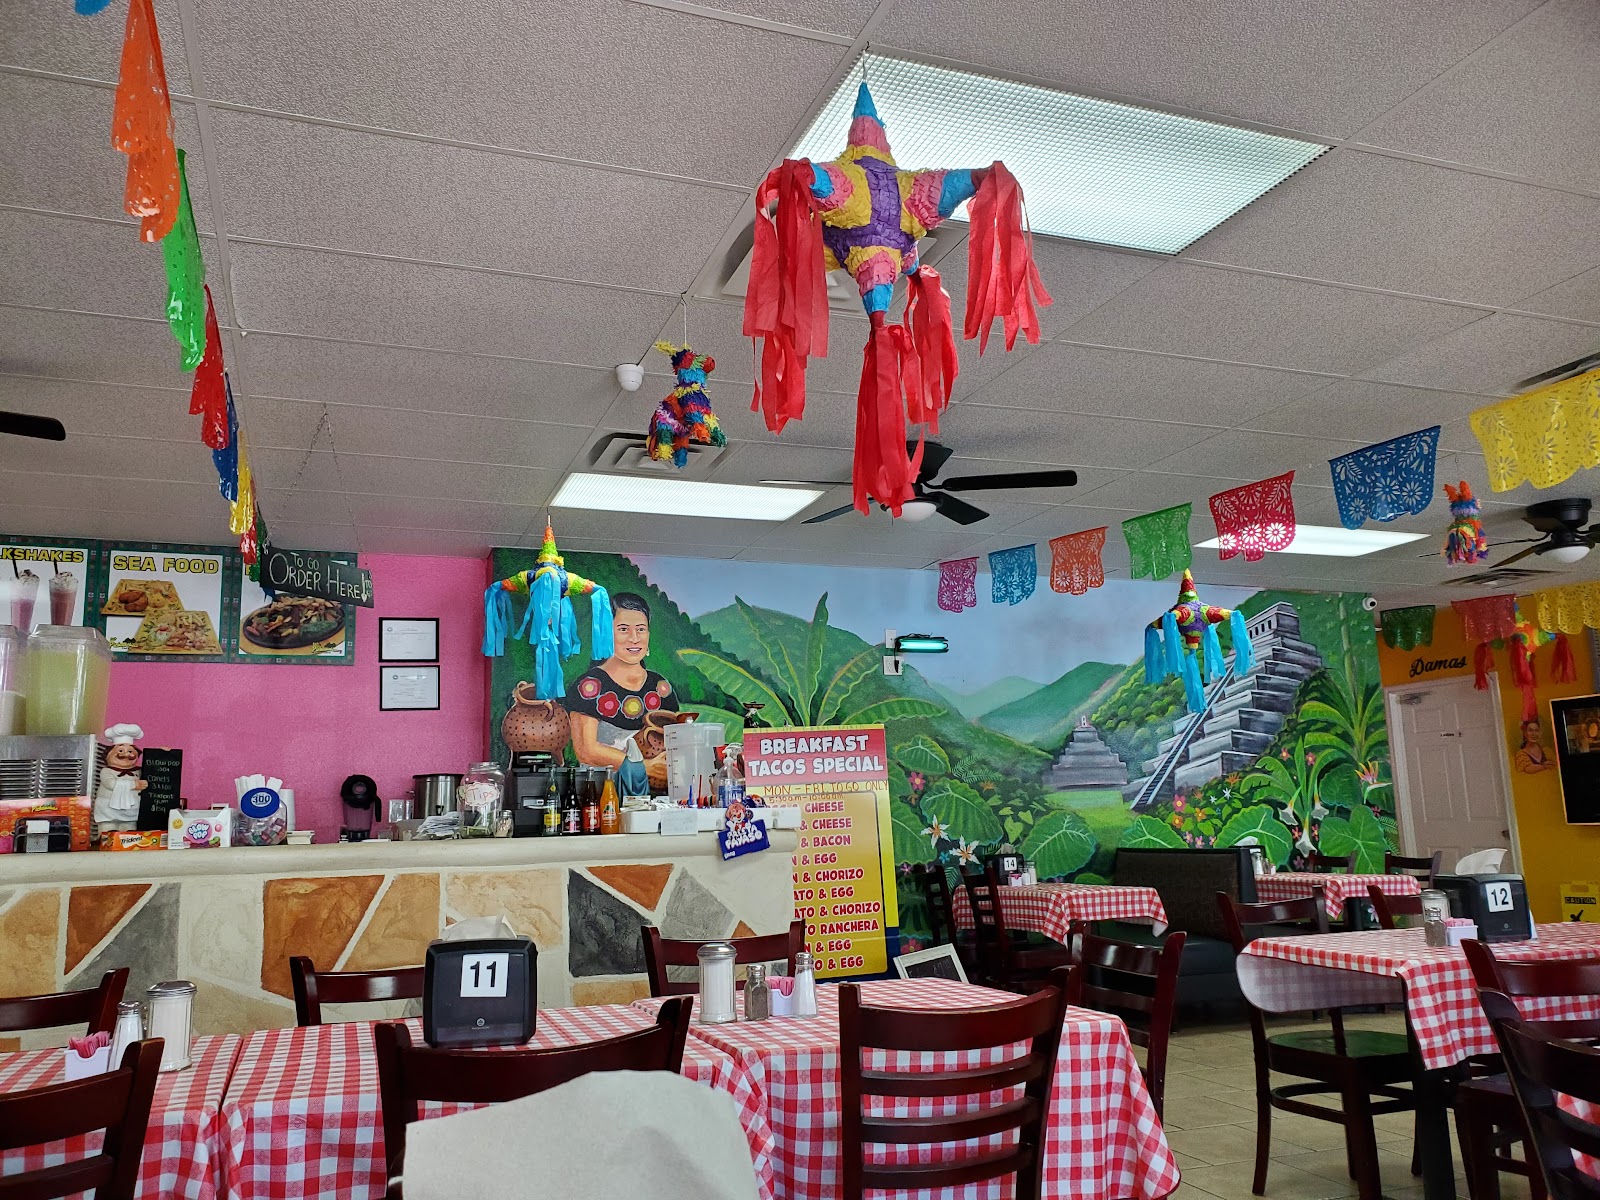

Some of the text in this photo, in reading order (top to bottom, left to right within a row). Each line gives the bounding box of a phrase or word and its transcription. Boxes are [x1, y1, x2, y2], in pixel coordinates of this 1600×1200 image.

[0, 547, 84, 563] KSHAKES
[290, 552, 319, 570] TO GO
[113, 555, 219, 574] SEA FOOD
[269, 552, 361, 599] ORDER HERE
[1409, 656, 1467, 678] Damas
[760, 734, 869, 756] BREAKFAST
[748, 755, 884, 777] TACOS SPECIAL
[468, 788, 494, 801] Tips
[764, 784, 791, 797] MON
[845, 780, 860, 793] GO
[865, 779, 888, 792] ONLY
[252, 794, 271, 803] 300
[804, 801, 844, 813] CHEESE
[800, 817, 852, 831] & CHEESE
[121, 835, 143, 845] Trident
[725, 830, 763, 849] PAYASO
[801, 834, 851, 848] & BACON
[802, 854, 810, 866] &
[814, 852, 837, 864] EGG
[1006, 859, 1015, 868] 14
[803, 872, 811, 883] &
[815, 868, 864, 882] CHORIZO
[818, 888, 827, 899] &
[831, 886, 854, 898] EGG
[1491, 887, 1509, 906] 12
[819, 905, 828, 917] &
[832, 901, 881, 915] CHORIZO
[820, 919, 879, 935] RANCHERA
[816, 941, 824, 953] &
[828, 939, 852, 951] EGG
[828, 958, 836, 970] &
[840, 956, 864, 969] EGG
[470, 960, 497, 988] 11
